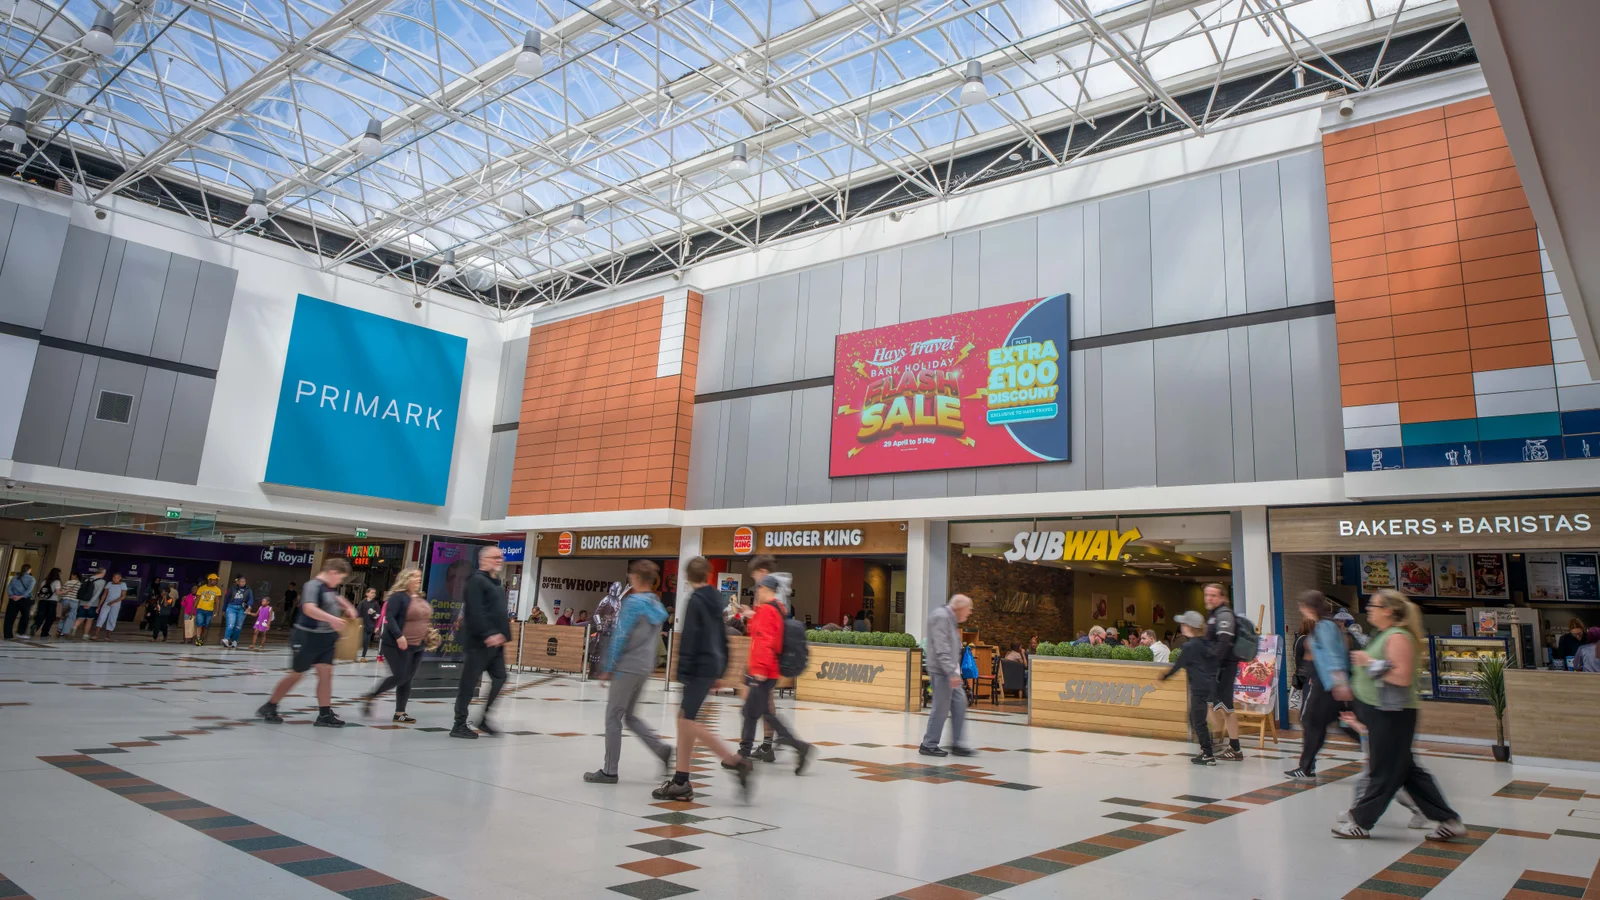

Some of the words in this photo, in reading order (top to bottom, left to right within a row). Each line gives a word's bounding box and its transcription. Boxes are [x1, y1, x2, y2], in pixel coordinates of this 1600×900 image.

[872, 347, 907, 362] Hays
[910, 336, 957, 356] Travel
[988, 340, 1058, 367] EXTRA
[871, 366, 900, 378] BANK
[988, 360, 1058, 391] £100
[863, 369, 960, 409] FLASH
[988, 385, 1057, 405] DISCOUNT
[295, 379, 443, 431] PRIMARK
[990, 410, 1015, 418] EXCLUSIVE
[857, 394, 965, 440] SALE
[893, 439, 908, 448] April
[922, 437, 936, 445] May
[1339, 518, 1437, 536] BAKERS
[1441, 520, 1454, 532] +
[1458, 513, 1592, 534] BARISTAS
[580, 536, 620, 549] BURGER
[622, 535, 649, 549] KING
[734, 540, 751, 548] KING
[765, 530, 821, 547] BURGER
[823, 529, 862, 546] KING
[1003, 526, 1143, 563] SUBWAY
[278, 552, 306, 566] Royal
[507, 546, 523, 556] Expert
[816, 661, 885, 684] SUBWAY
[1058, 679, 1156, 707] SUBWAY
